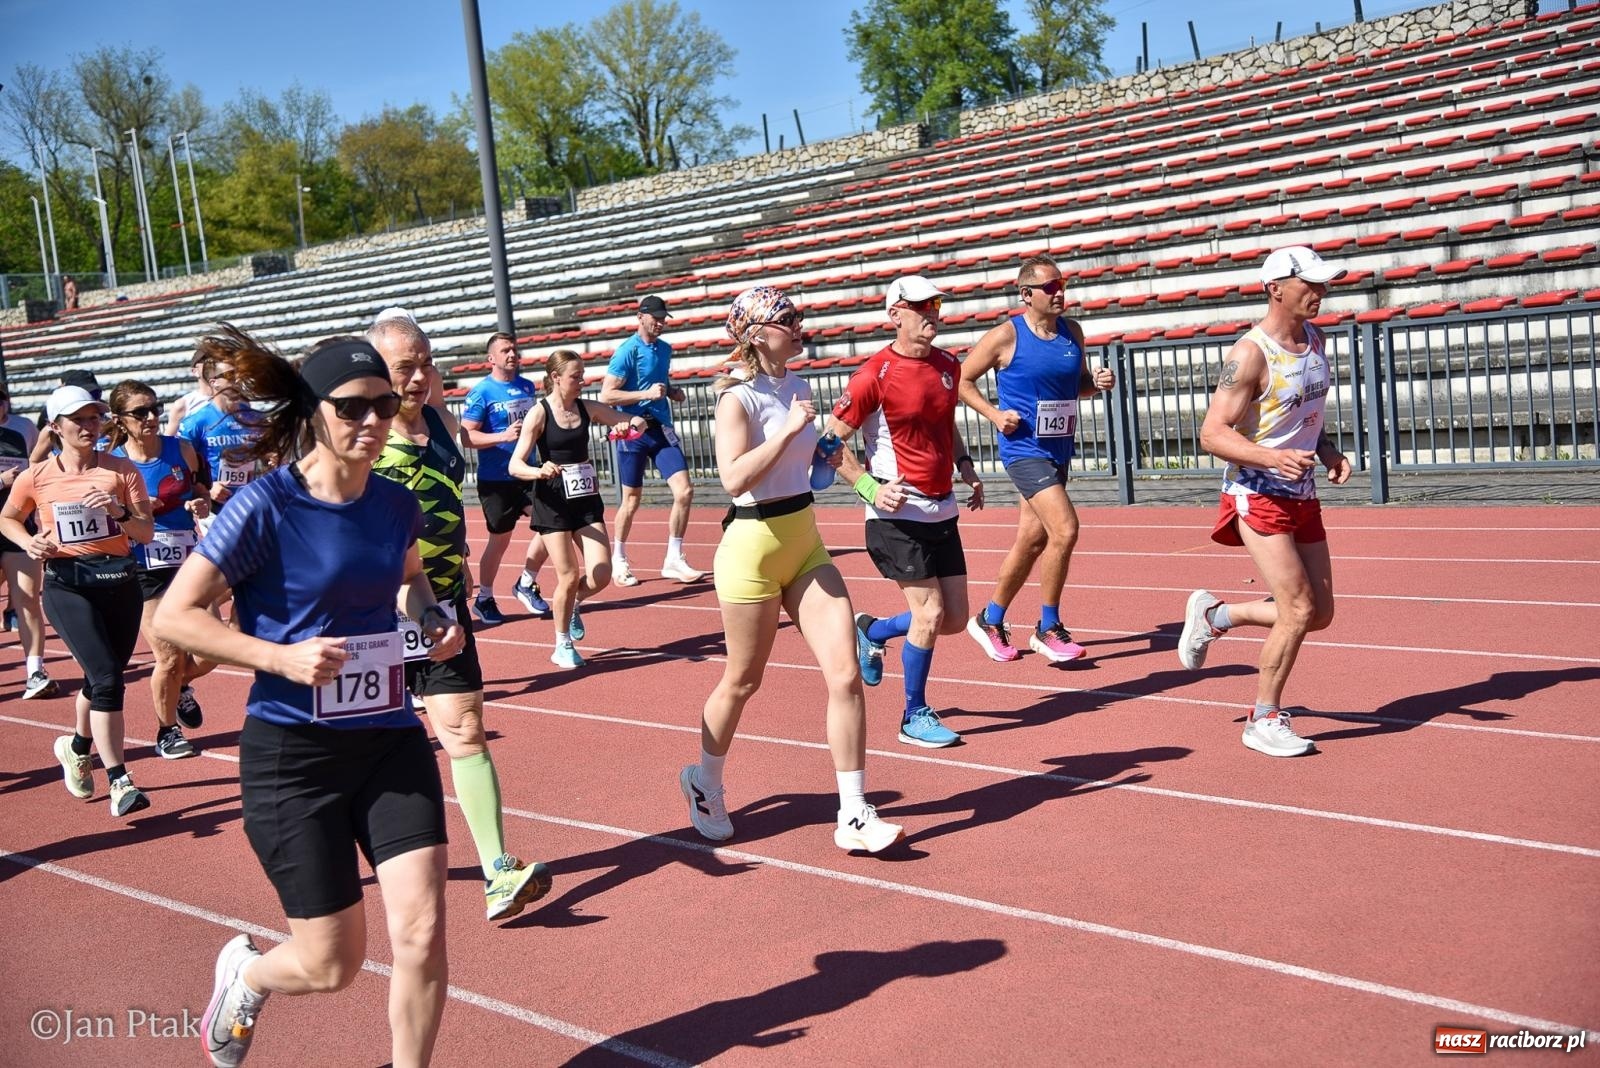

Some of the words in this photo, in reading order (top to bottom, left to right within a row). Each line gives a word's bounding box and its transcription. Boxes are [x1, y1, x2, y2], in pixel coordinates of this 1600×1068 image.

[1044, 416, 1065, 431] 143
[225, 471, 245, 482] 159
[571, 477, 592, 491] 232
[69, 518, 99, 537] 114
[154, 546, 182, 561] 125
[342, 642, 355, 651] IEG
[356, 641, 367, 651] BEZ
[333, 669, 380, 704] 178
